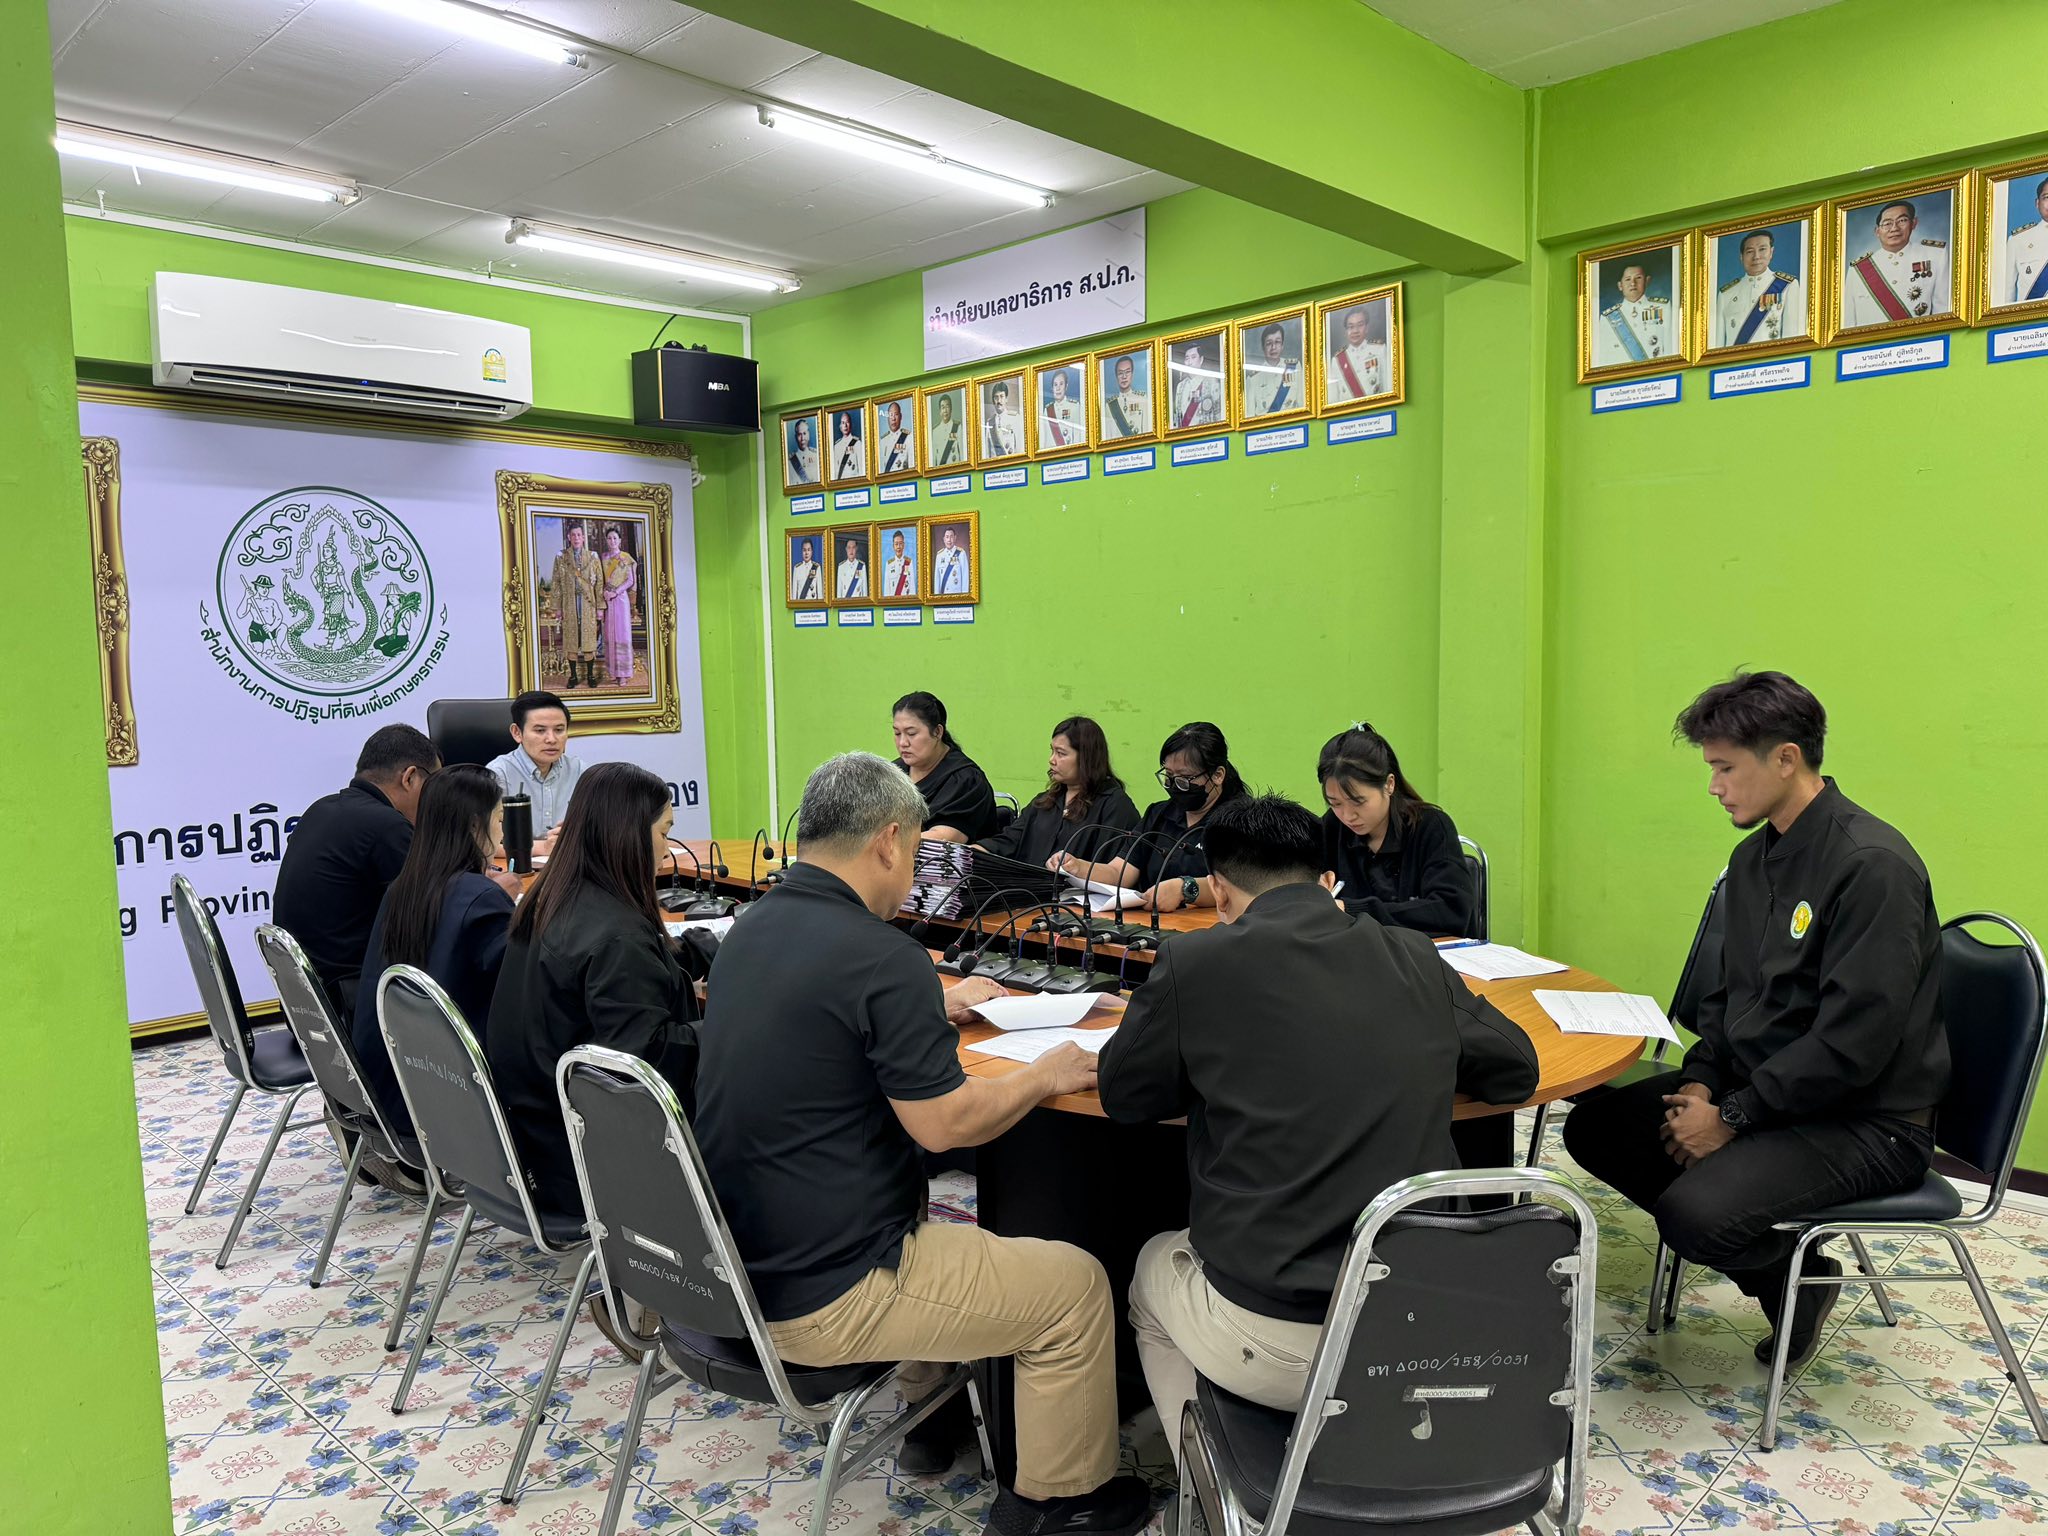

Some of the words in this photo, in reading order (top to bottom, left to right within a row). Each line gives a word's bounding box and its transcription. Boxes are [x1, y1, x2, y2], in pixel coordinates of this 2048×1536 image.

[928, 280, 1073, 332] ทำเนียบเลขาธิการ
[1079, 264, 1136, 294] ส.ป.ก.
[707, 381, 730, 391] MBA
[200, 627, 451, 724] สำนักงานการปฏิรูปที่ดินเพื่อเกษตรกรรม
